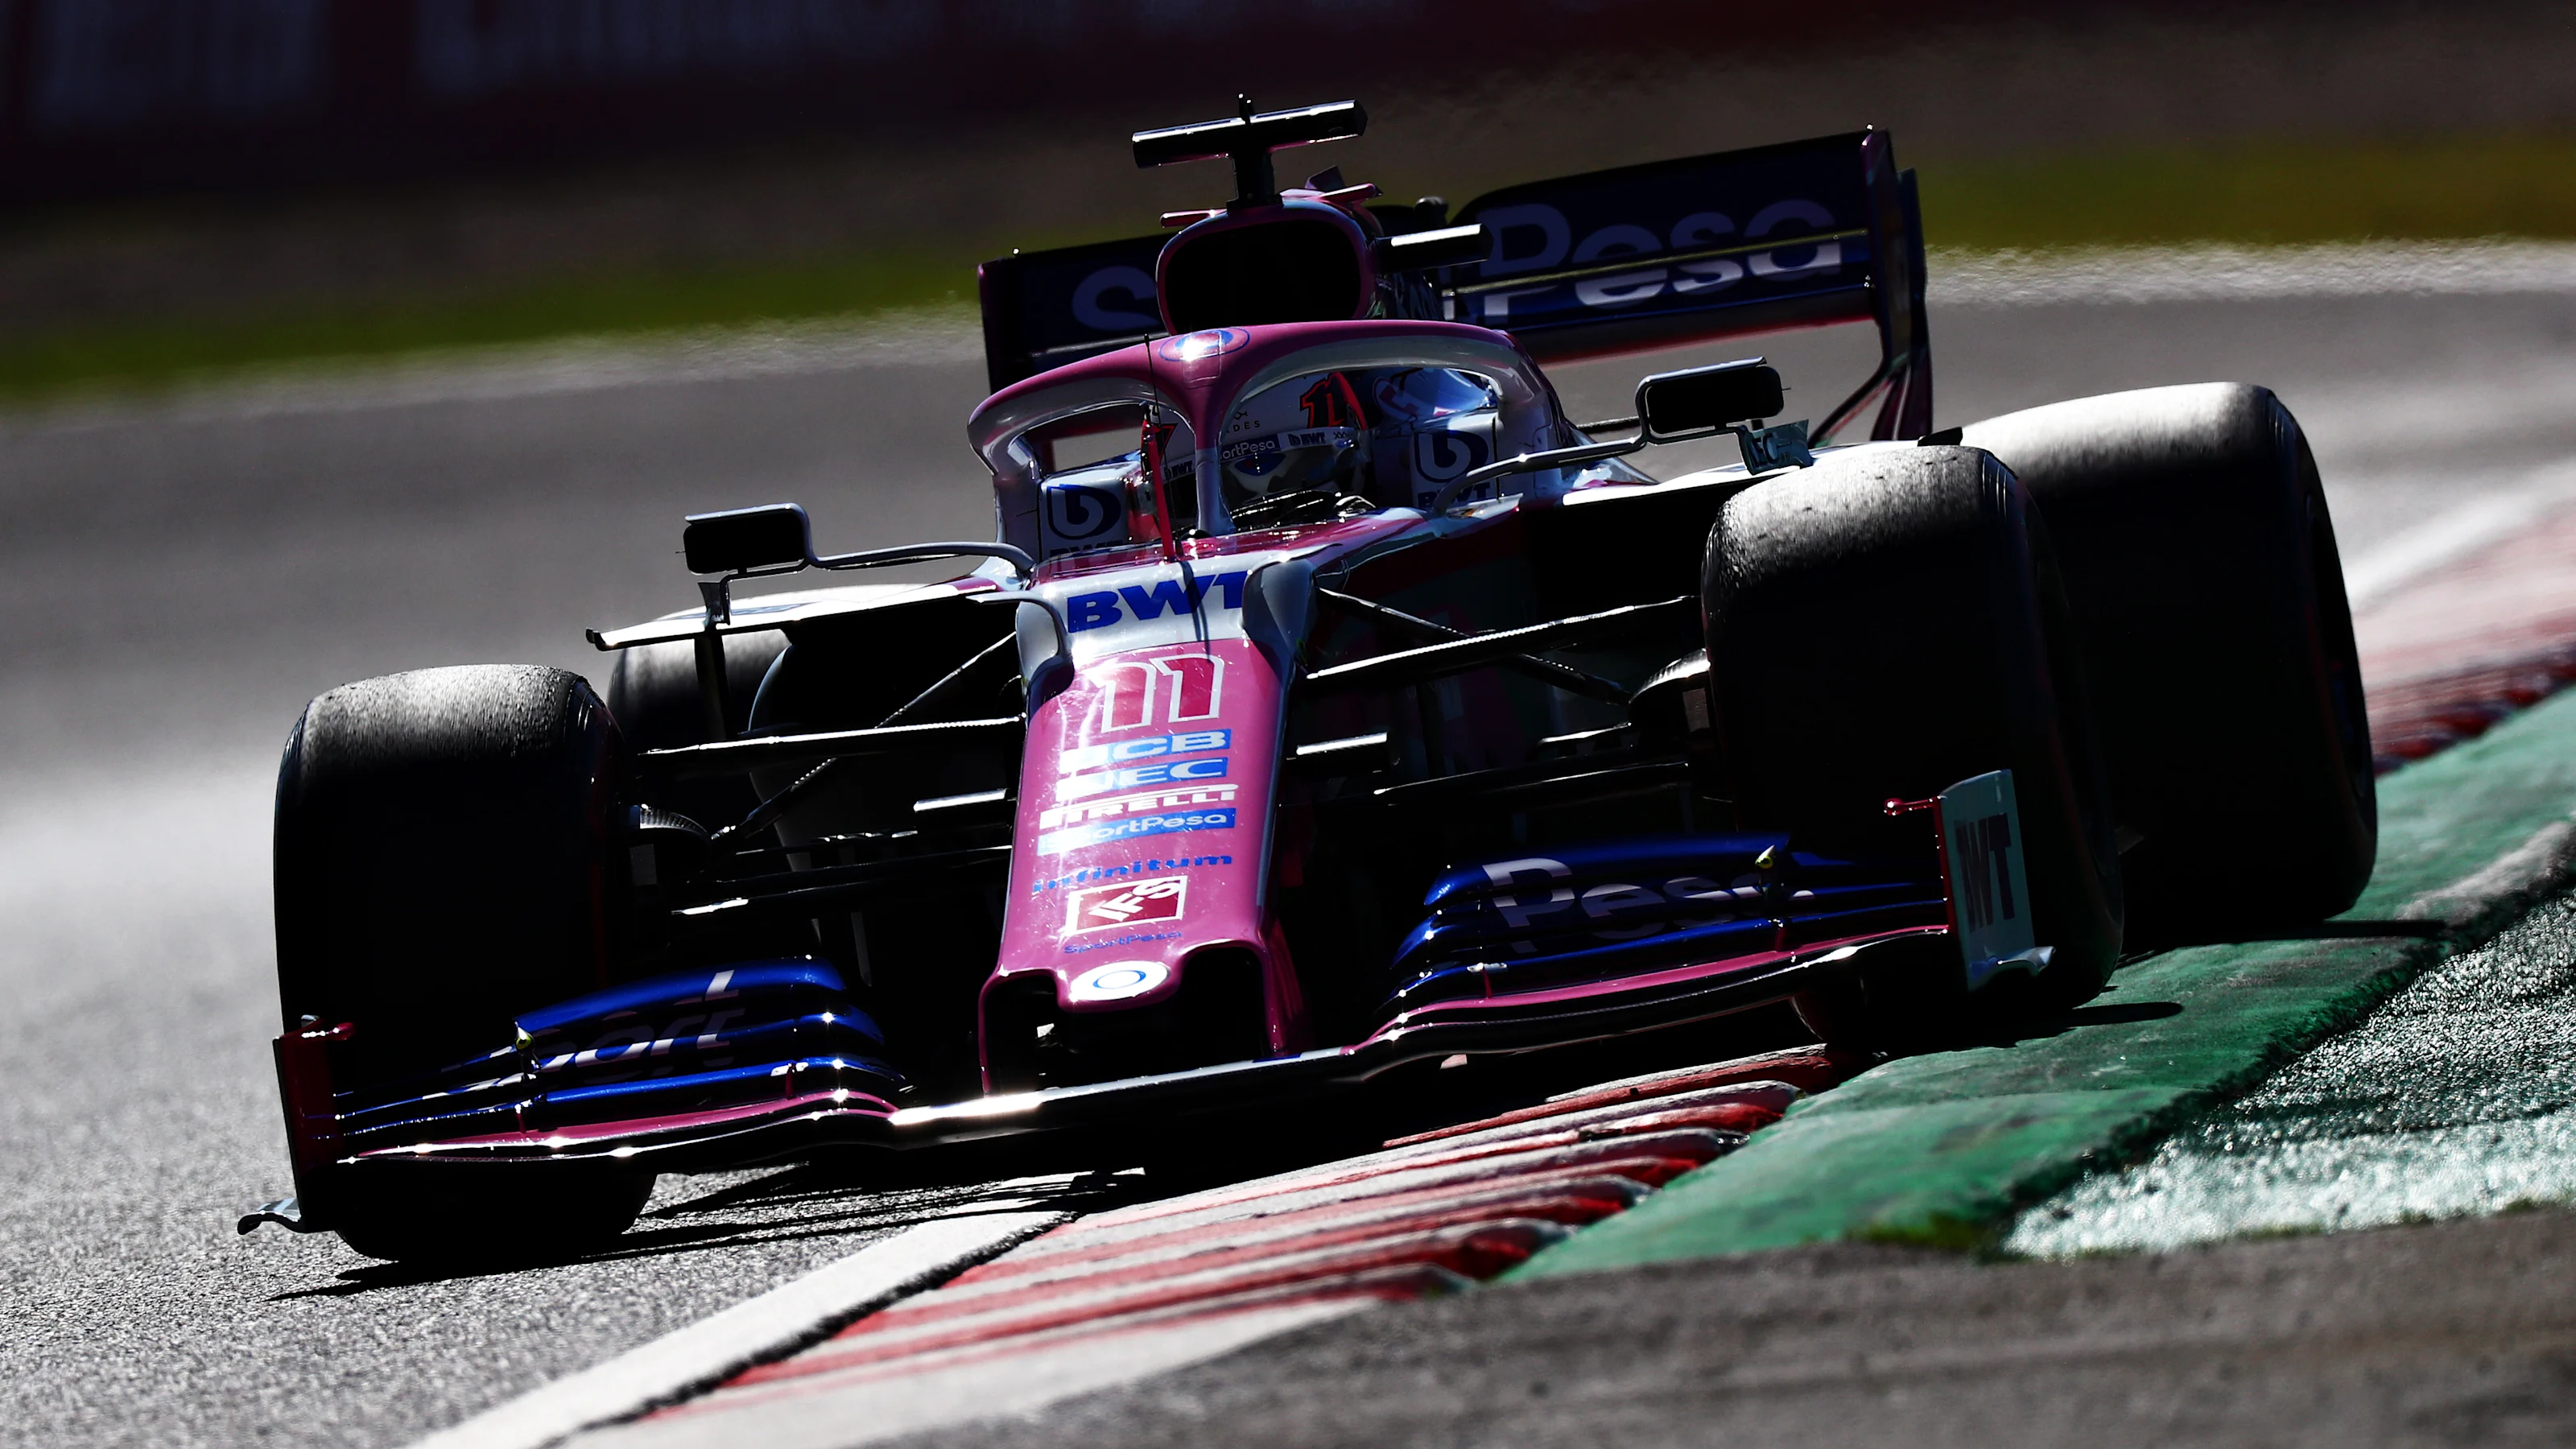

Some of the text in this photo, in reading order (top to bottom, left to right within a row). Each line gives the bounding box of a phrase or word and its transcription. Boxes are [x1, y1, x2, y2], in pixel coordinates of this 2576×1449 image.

[1220, 438, 1276, 461] ortPesa
[1067, 571, 1249, 633] BWT
[1081, 653, 1225, 733] 11
[1039, 783, 1240, 830] PIRELLI
[1045, 814, 1228, 852] ortPesa
